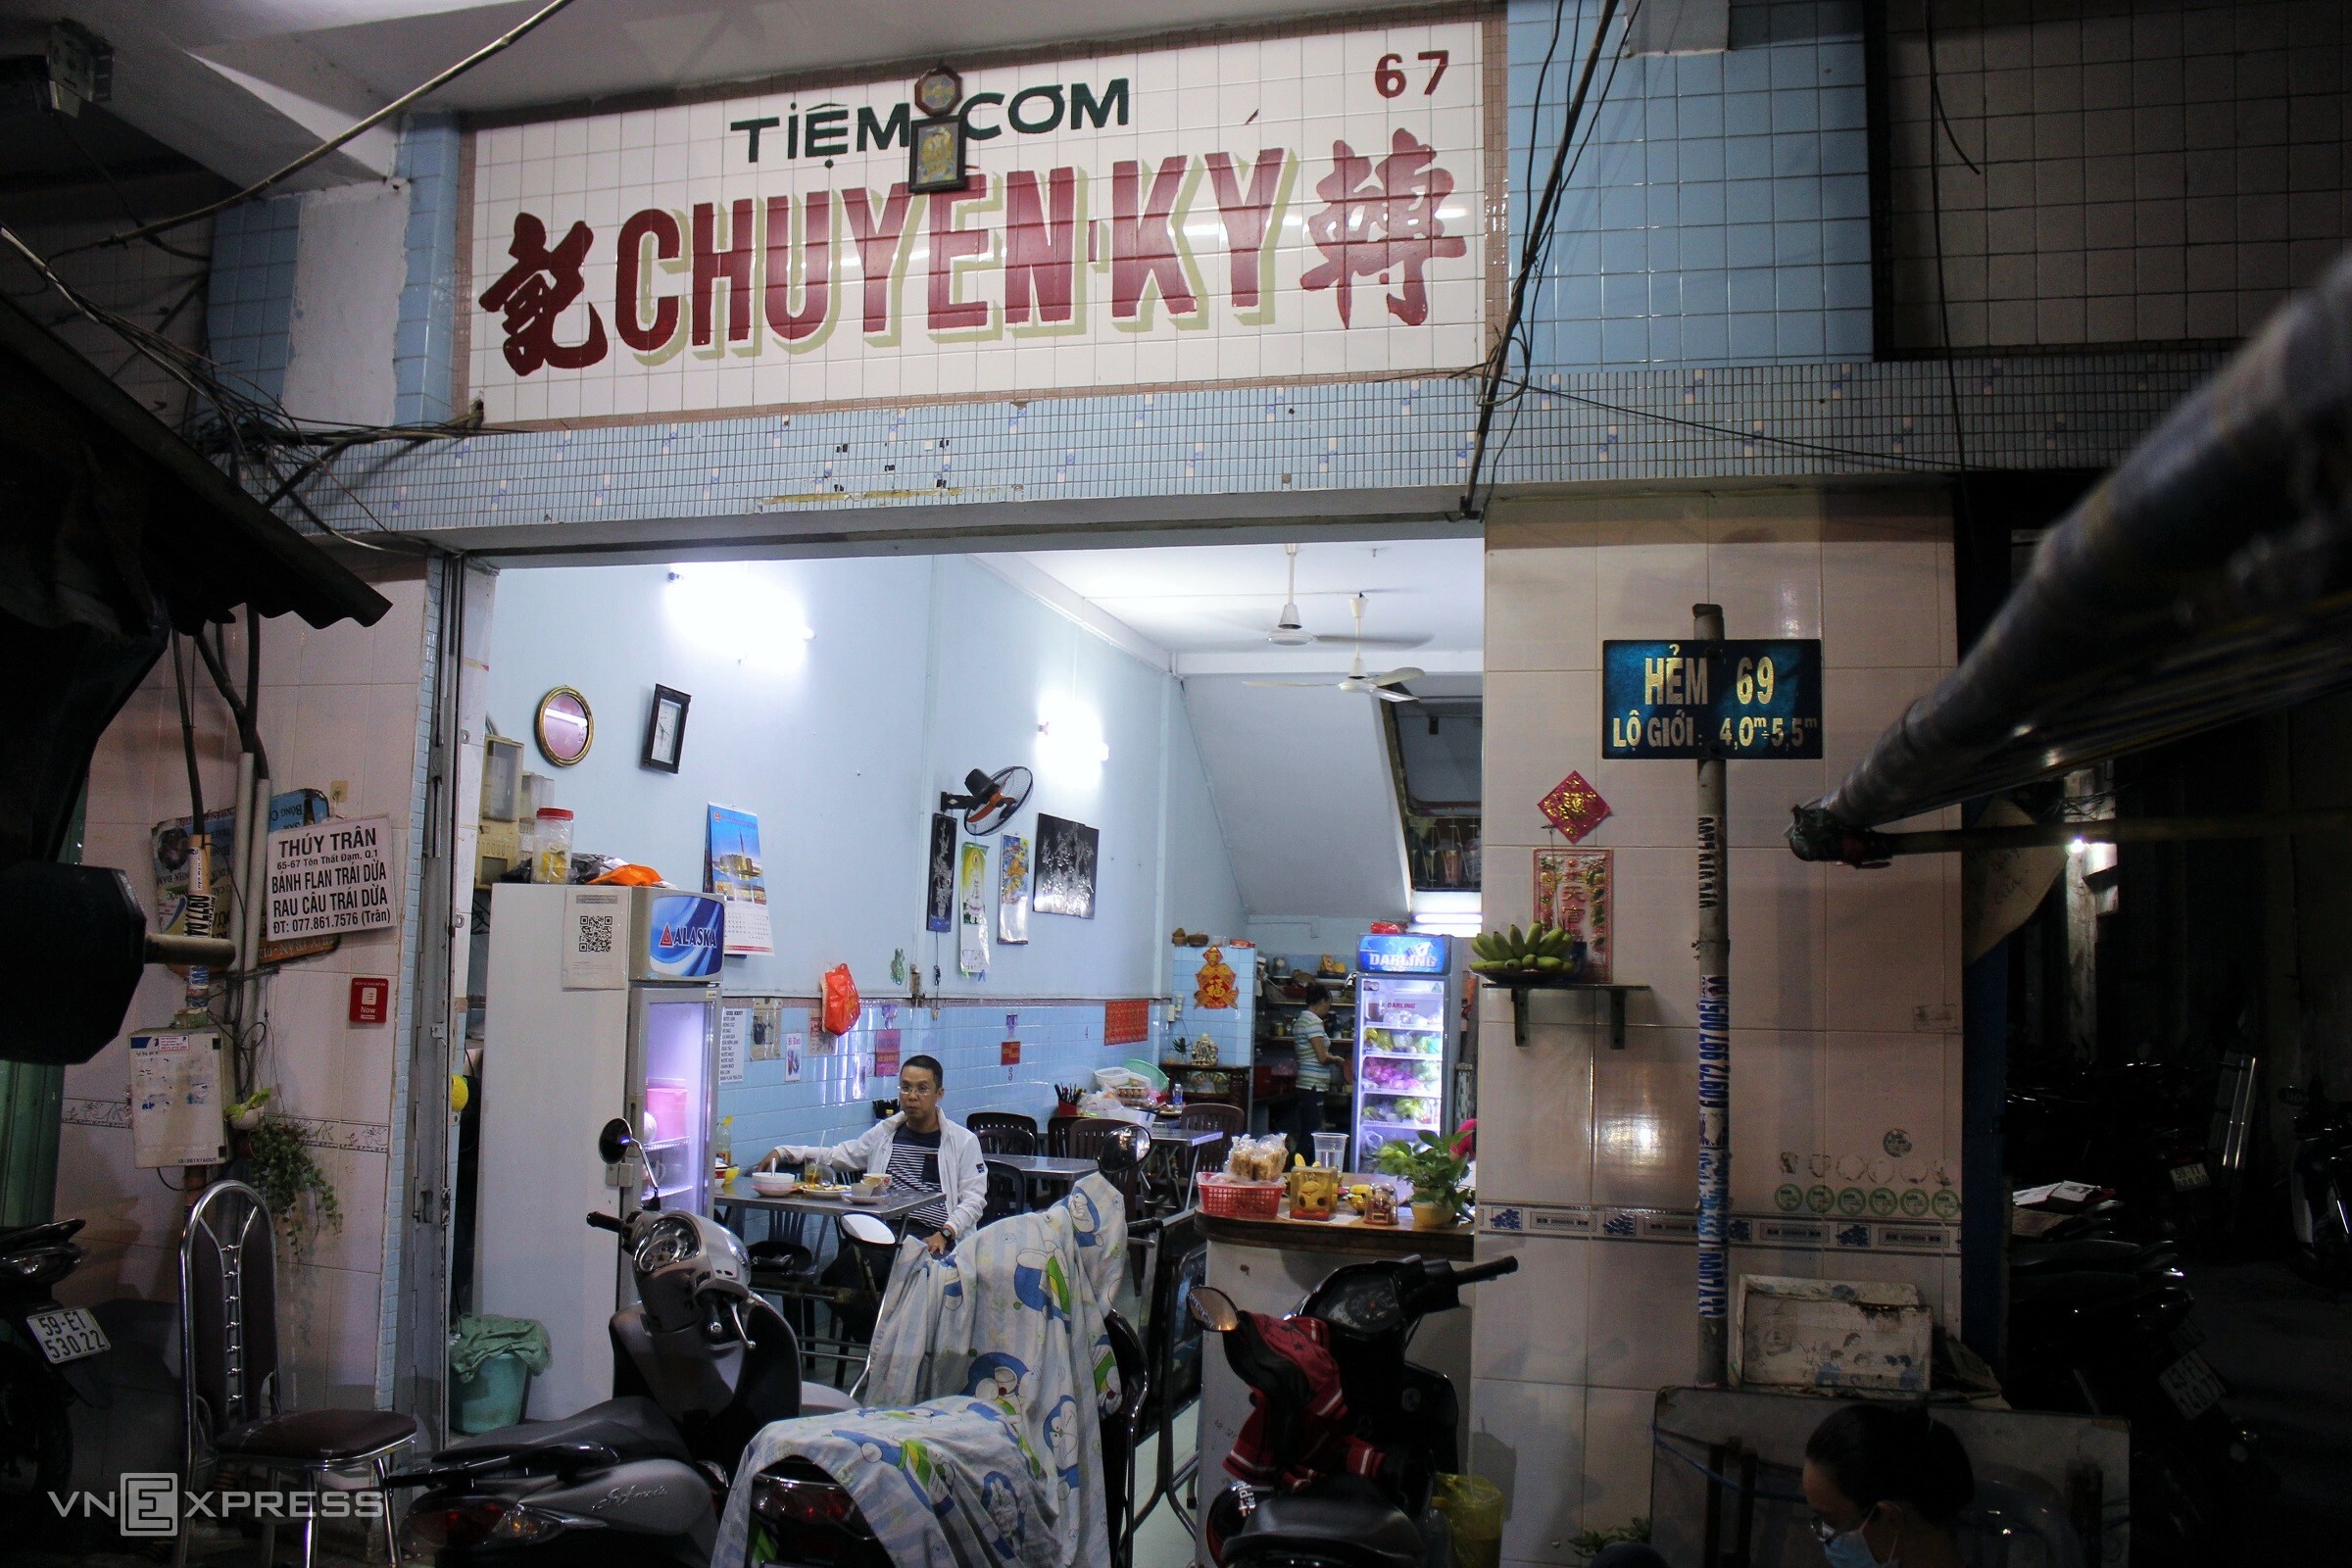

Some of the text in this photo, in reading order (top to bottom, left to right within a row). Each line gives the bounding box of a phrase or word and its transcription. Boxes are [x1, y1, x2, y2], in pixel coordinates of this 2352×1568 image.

[1375, 49, 1449, 98] 67
[958, 77, 1129, 141] CƠM
[1644, 643, 1775, 706] HẺM 69
[1612, 709, 1642, 751] LỘ
[278, 825, 376, 858] THÚY TRÂN
[271, 858, 387, 894] BÁNH FLAN TRÁI DỪA
[276, 859, 301, 870] 65-67
[304, 858, 318, 867] Tôn
[365, 849, 378, 859] Q.1
[273, 883, 388, 918] RAU CÂU TRÁI DỪA
[292, 911, 359, 933] 077.861.7576
[361, 907, 391, 927] (Trân)
[673, 926, 717, 948] ALASKA
[1369, 953, 1438, 967] DARLING
[38, 1310, 86, 1337] 59-E1
[44, 1329, 105, 1359] 530.22
